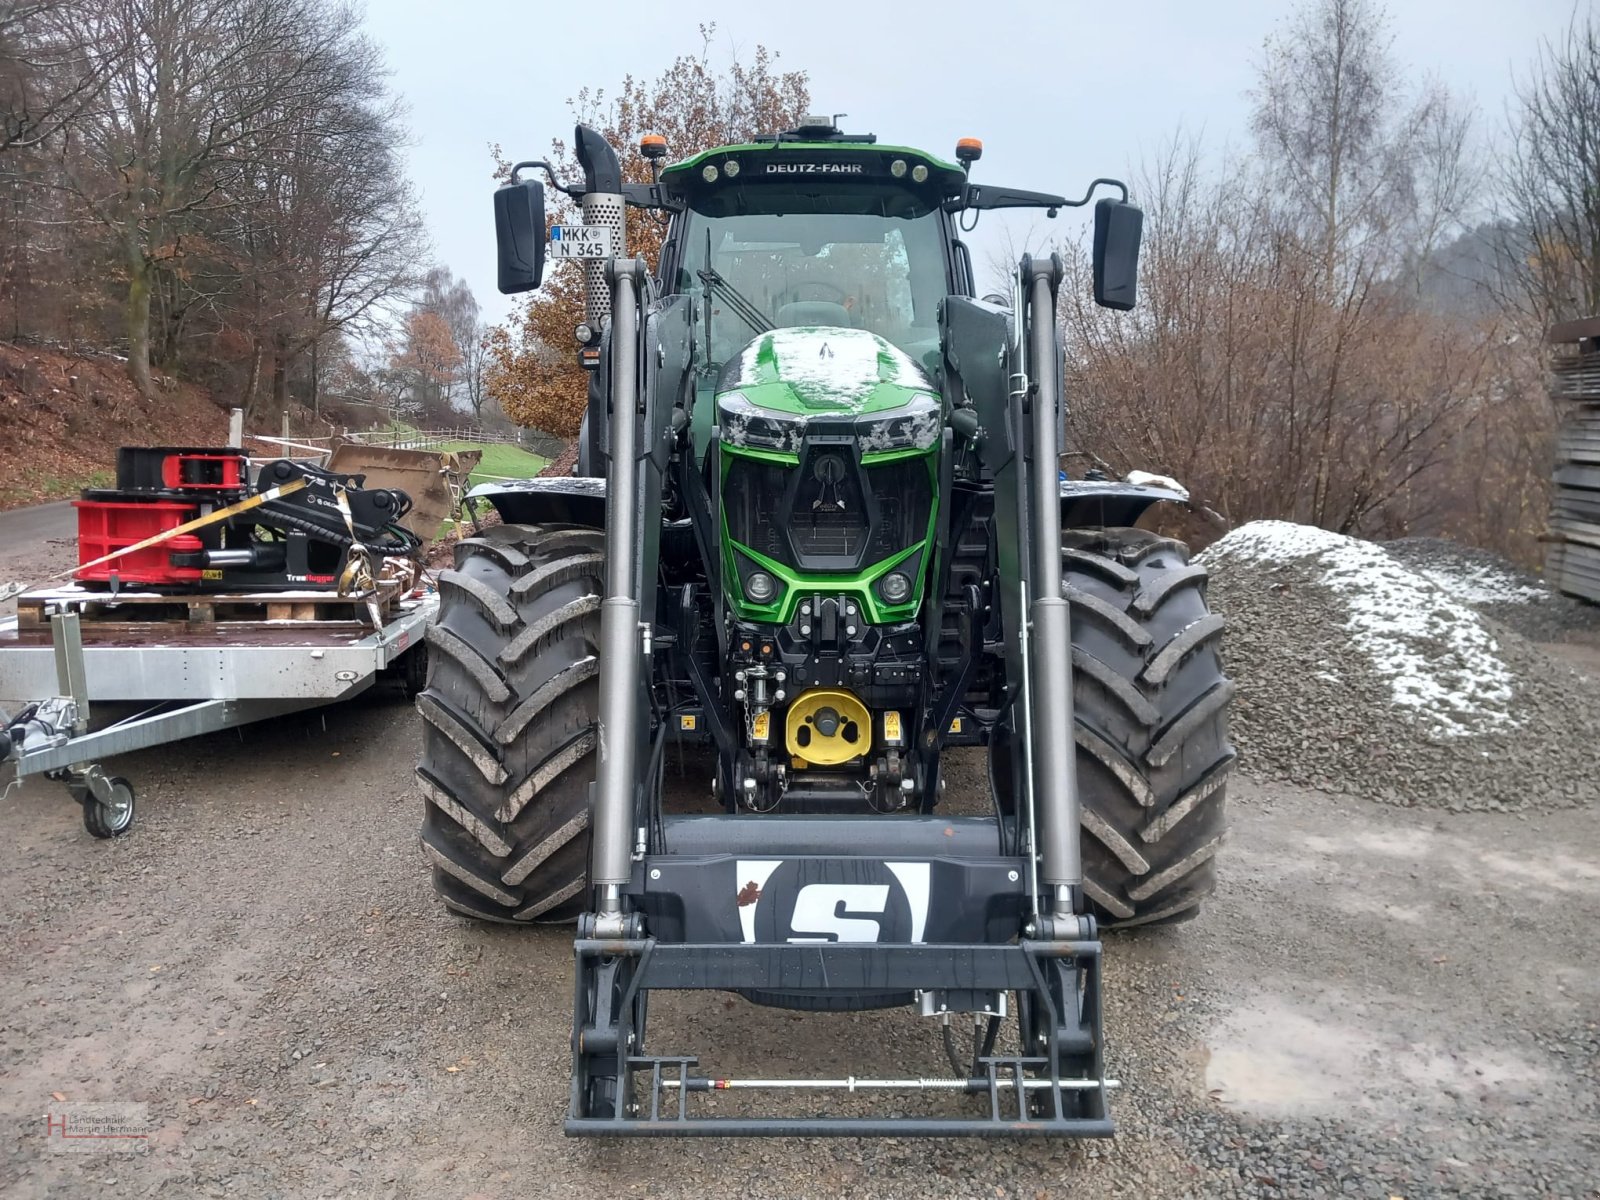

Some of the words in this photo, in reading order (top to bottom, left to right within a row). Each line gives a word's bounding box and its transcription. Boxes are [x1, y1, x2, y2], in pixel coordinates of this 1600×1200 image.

[766, 164, 863, 173] DEUTZ-FAHR
[562, 228, 590, 241] MKK
[561, 243, 570, 256] N
[577, 243, 603, 256] 345
